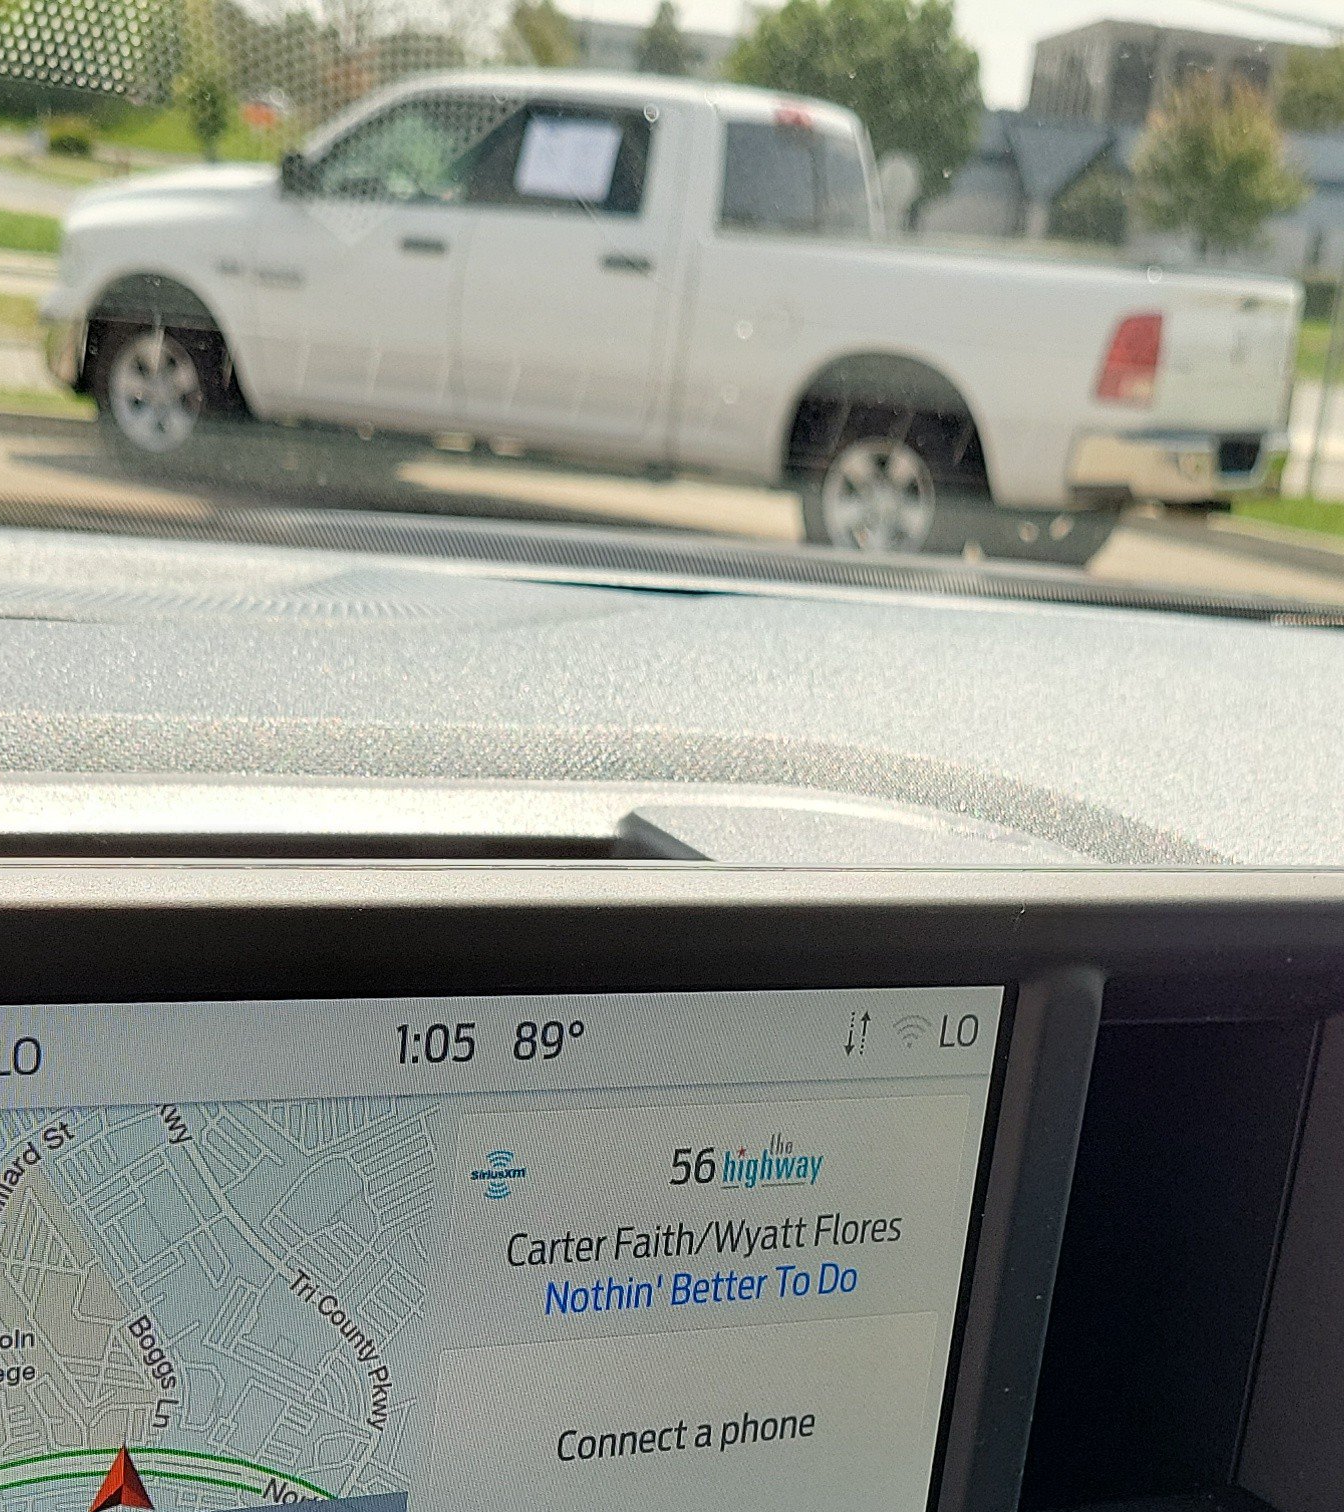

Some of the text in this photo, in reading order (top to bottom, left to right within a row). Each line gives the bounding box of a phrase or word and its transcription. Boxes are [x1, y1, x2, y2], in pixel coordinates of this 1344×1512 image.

[396, 1018, 586, 1065] 1:05 89°
[939, 1012, 980, 1049] LO
[43, 1121, 76, 1150] St
[769, 1132, 793, 1156] the
[668, 1146, 825, 1189] 56 highway
[506, 1212, 903, 1268] Carter Faith/Wyatt Flores
[544, 1262, 858, 1316] Nothin' Better To Do
[128, 1313, 180, 1428] Boggs Ln
[317, 1294, 380, 1363] County
[366, 1364, 393, 1432] Pkwy
[556, 1411, 817, 1463] Connect a phone
